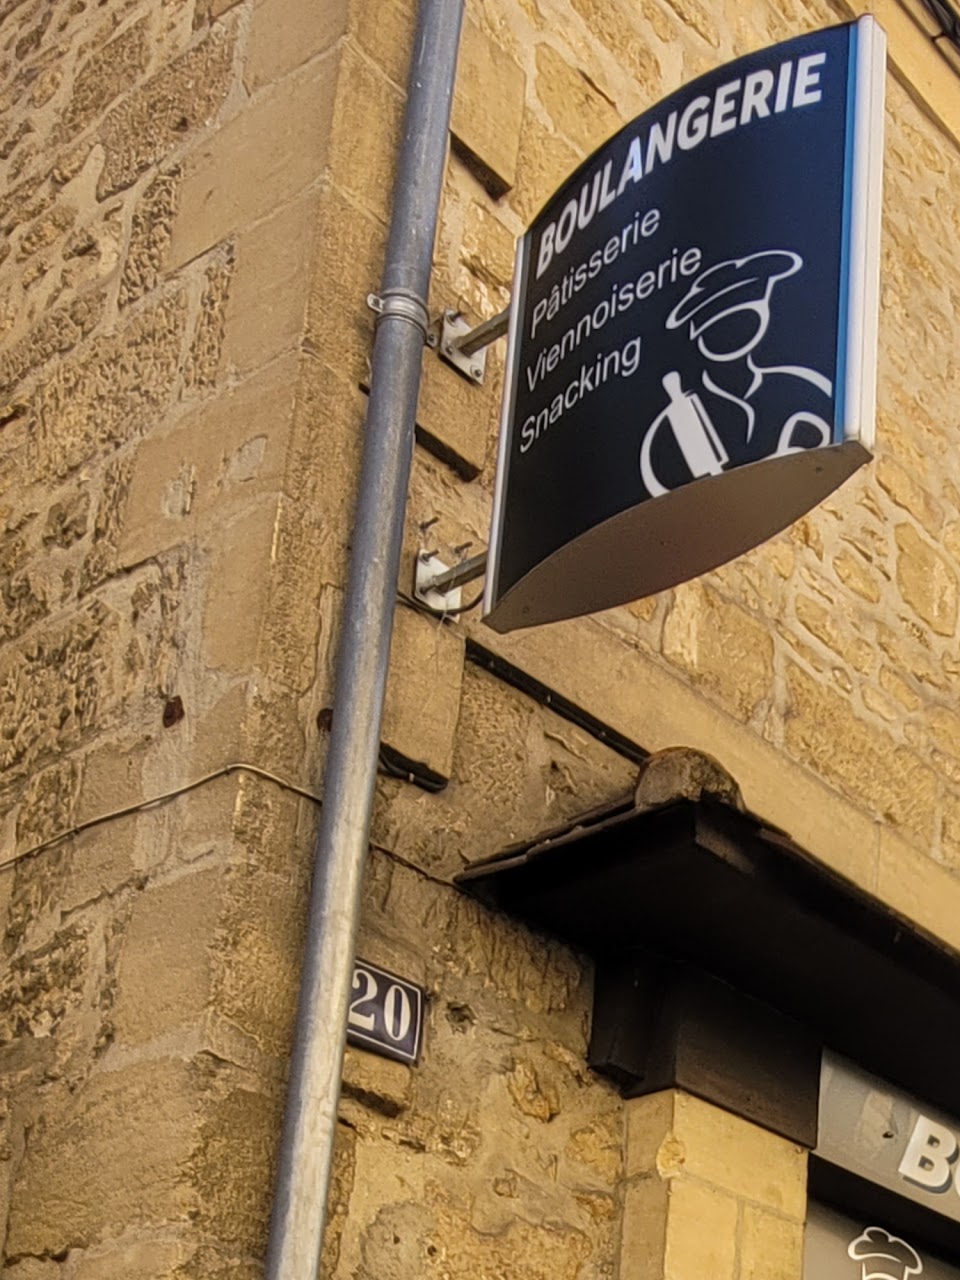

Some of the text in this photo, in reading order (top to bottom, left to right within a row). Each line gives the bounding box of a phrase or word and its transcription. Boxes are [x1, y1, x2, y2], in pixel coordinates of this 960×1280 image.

[535, 51, 827, 280] BOULANGERIE
[525, 246, 702, 393] Viennoiserie
[530, 207, 661, 339] Pâtisserie
[519, 335, 642, 454] Snacking
[348, 969, 411, 1041] 20
